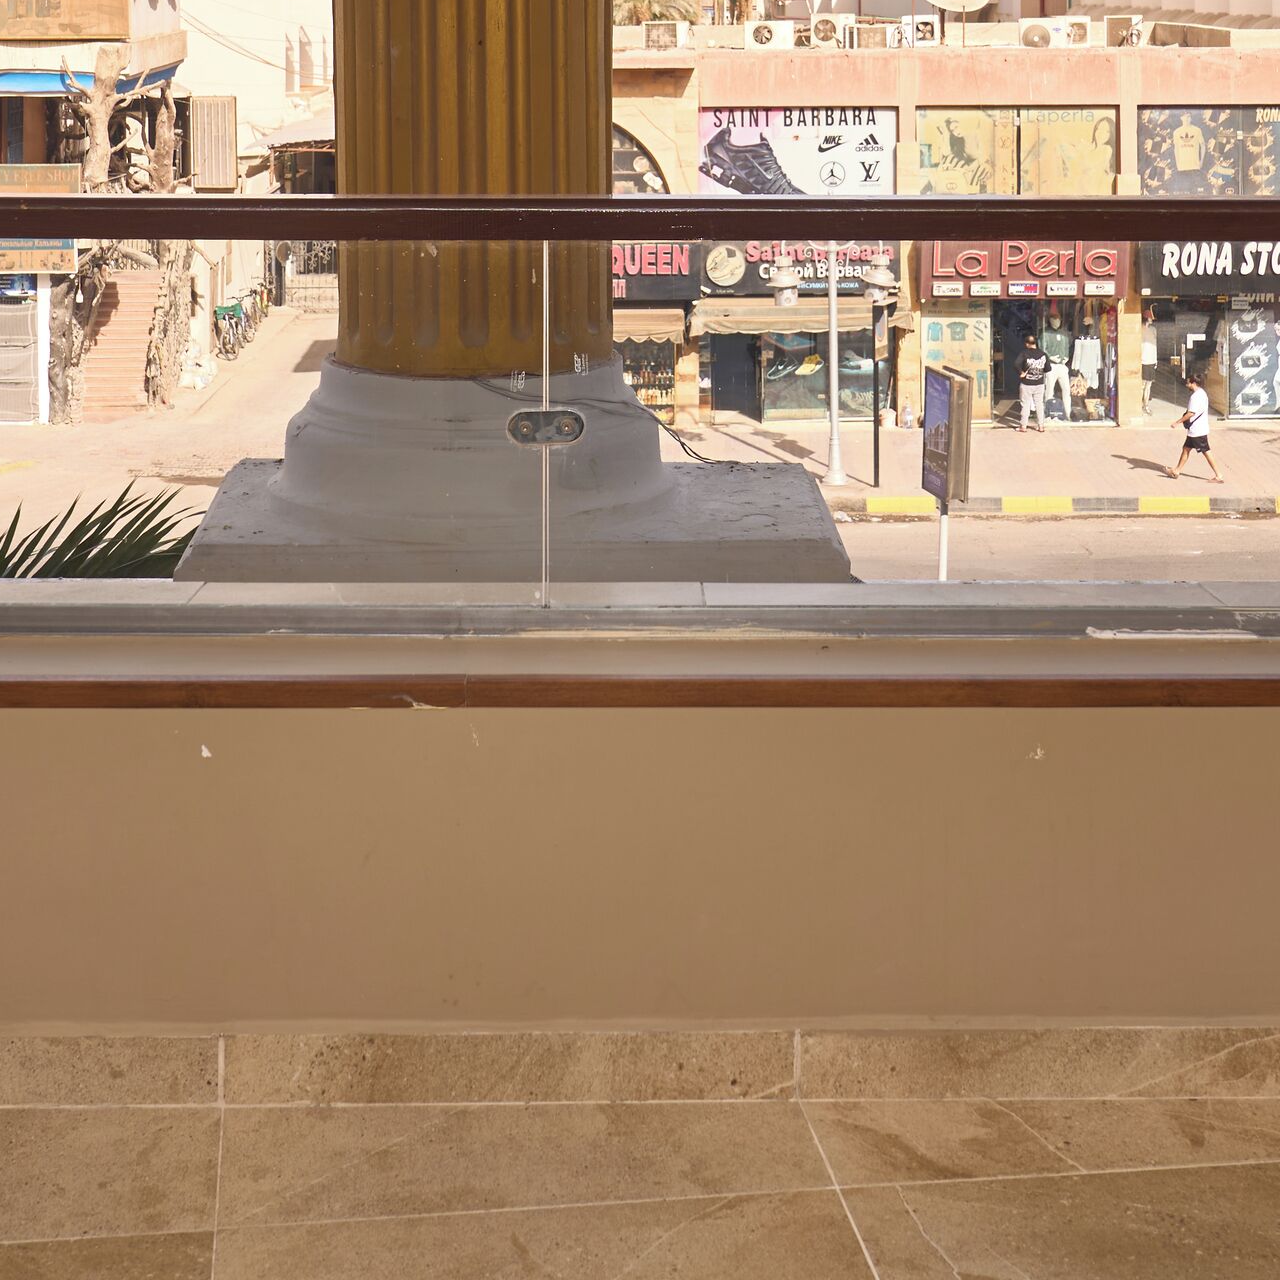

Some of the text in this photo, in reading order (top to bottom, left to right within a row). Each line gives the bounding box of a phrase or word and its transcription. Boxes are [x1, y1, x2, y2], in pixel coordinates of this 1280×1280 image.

[713, 107, 877, 128] SAINT BARBARA
[1026, 108, 1095, 125] Laperla
[822, 135, 844, 144] NIKE
[854, 144, 884, 152] adidas
[612, 244, 690, 277] QUEEN
[933, 240, 1118, 277] La Perla
[1162, 241, 1233, 278] RONA
